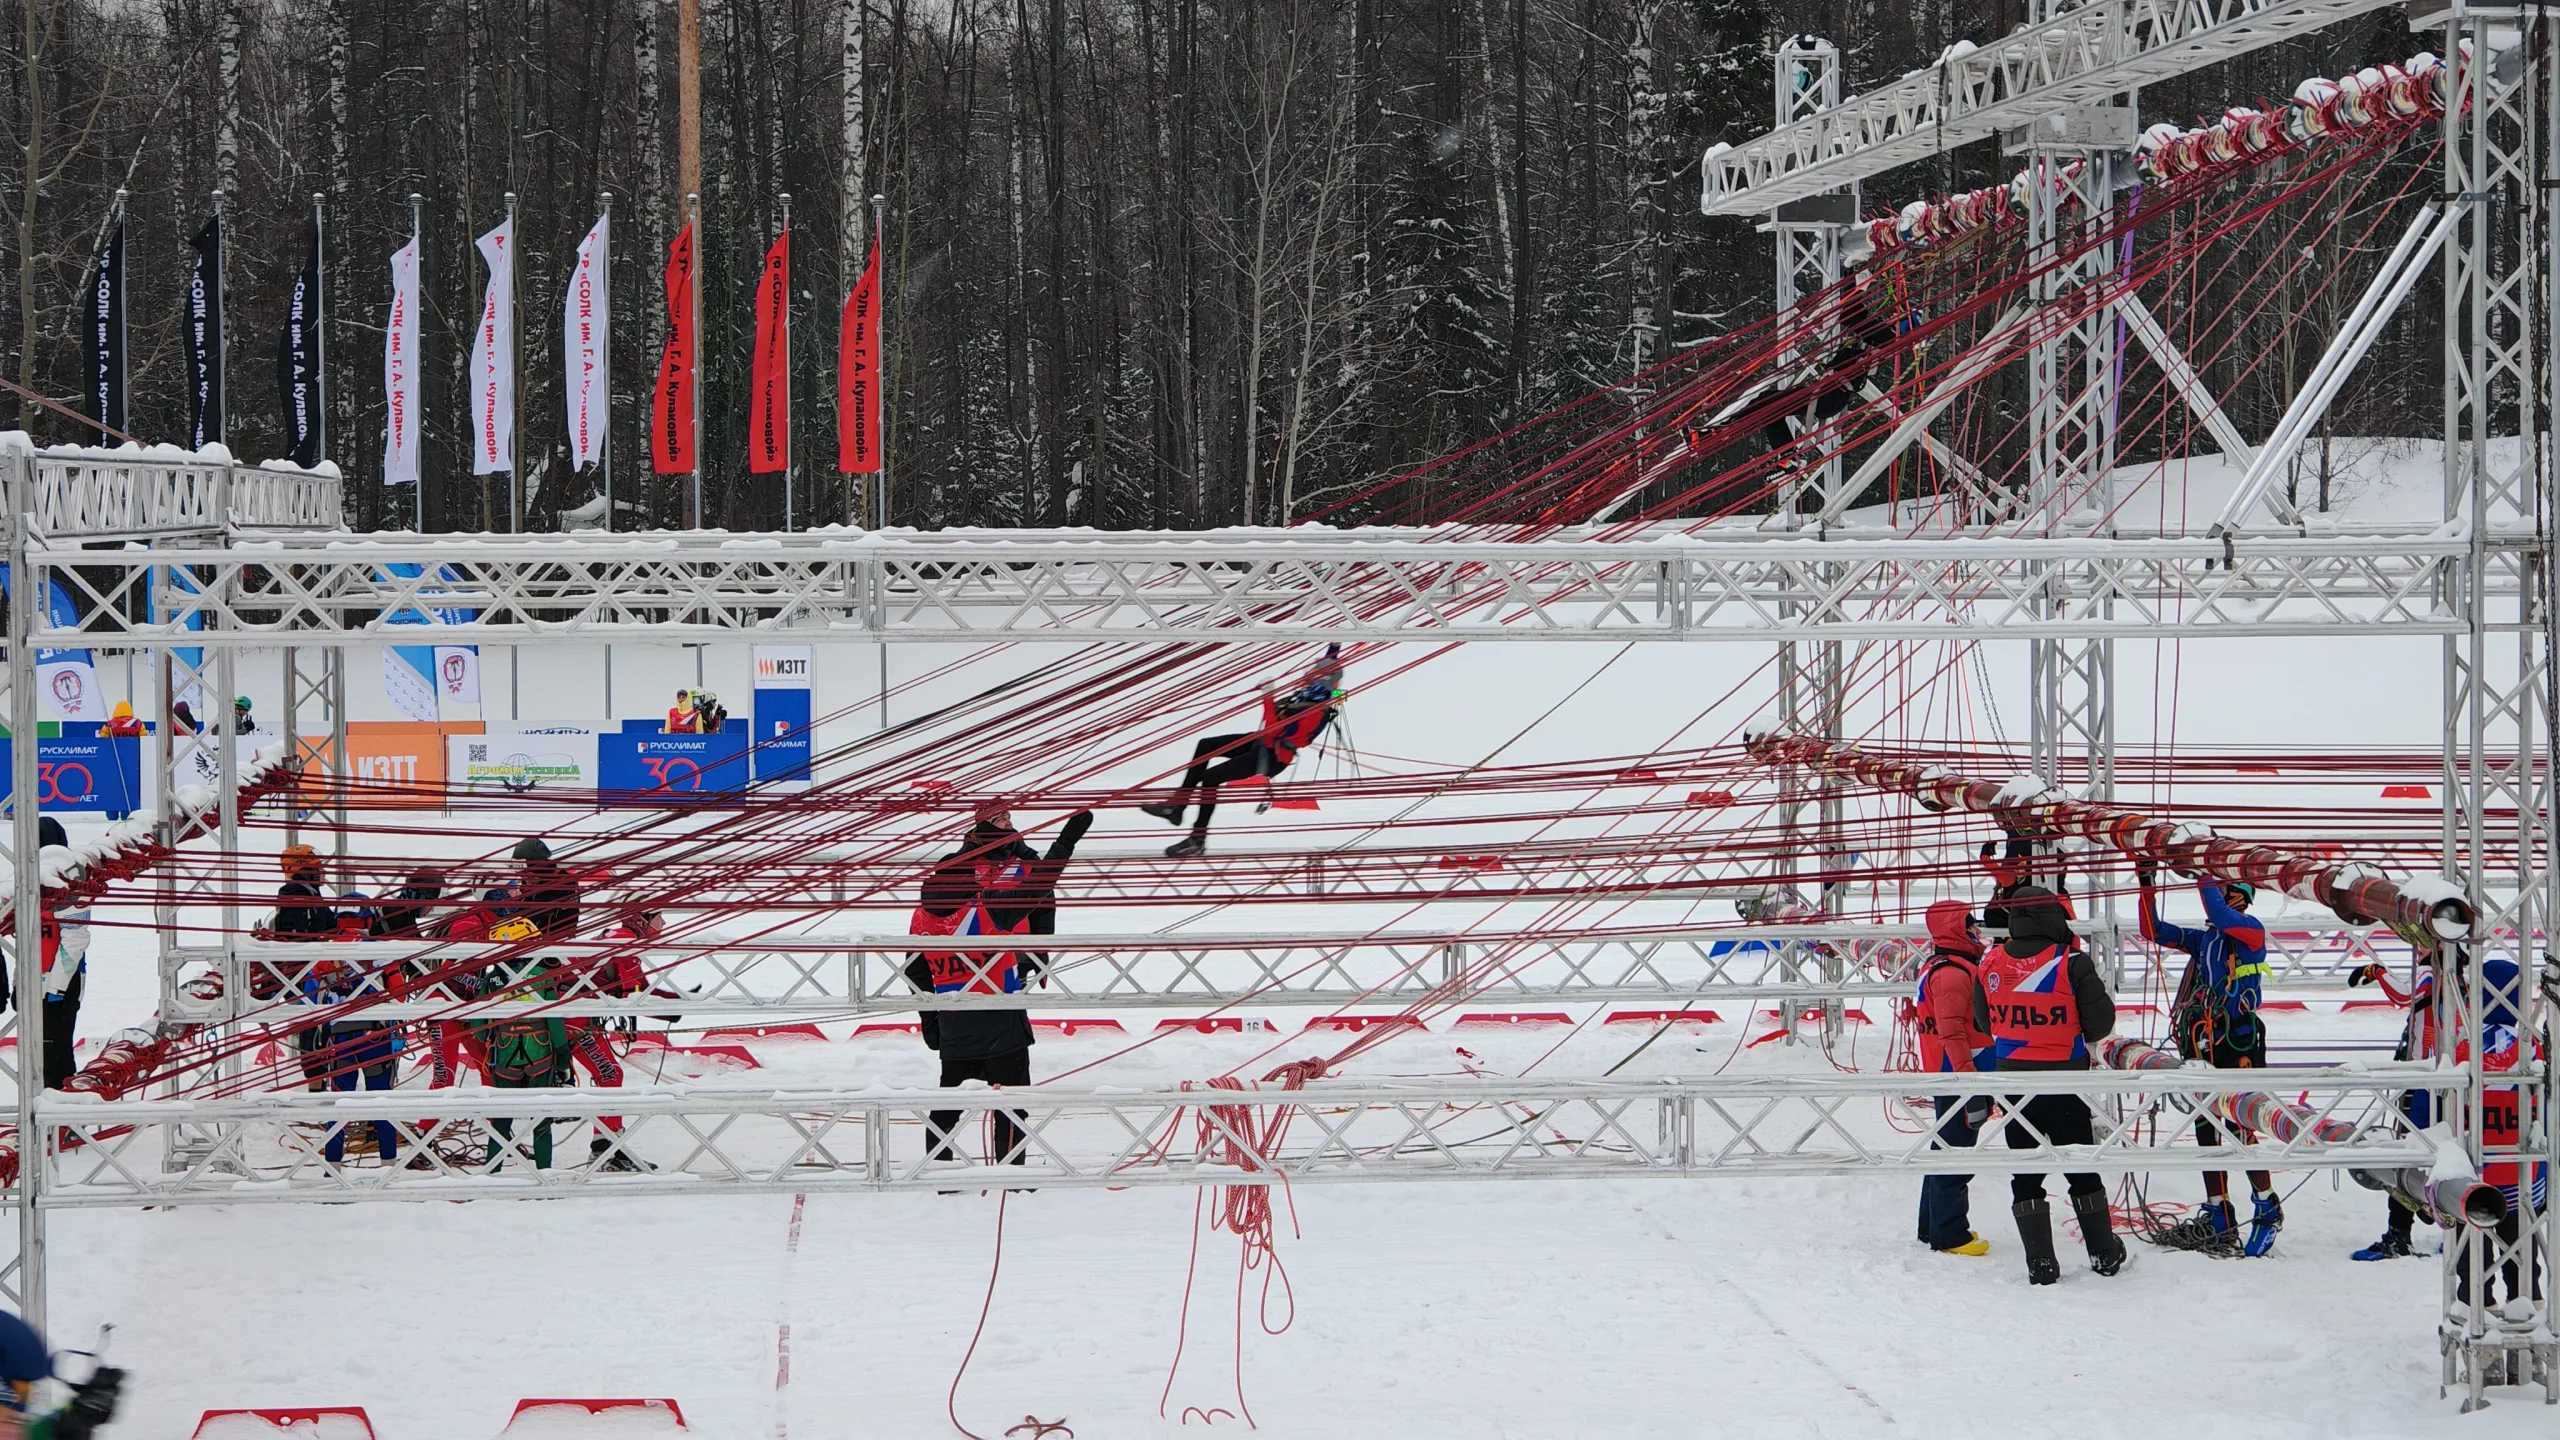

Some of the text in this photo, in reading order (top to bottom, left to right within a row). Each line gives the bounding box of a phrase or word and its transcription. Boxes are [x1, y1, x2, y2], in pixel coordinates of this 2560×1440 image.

[579, 273, 591, 318] «СОЛК
[98, 323, 108, 346] им.
[194, 322, 205, 346] им.
[291, 324, 302, 348] им.
[486, 324, 495, 347] им.
[580, 322, 591, 345] им.
[855, 323, 865, 345] им.
[392, 332, 403, 355] им.
[99, 351, 109, 359] Г.
[197, 350, 205, 359] Г.
[293, 351, 304, 360] Г.
[487, 351, 495, 360] Г.
[583, 349, 593, 357] Г.
[671, 350, 681, 359] Г.
[856, 349, 866, 358] Г.
[99, 364, 108, 378] А.
[198, 363, 207, 378] А.
[393, 359, 402, 369] Г.
[583, 362, 594, 376] А.
[670, 364, 680, 377] А.
[855, 362, 866, 376] А.
[293, 365, 305, 379] А.
[487, 365, 495, 378] А.
[393, 373, 403, 387] А.
[486, 382, 499, 463] Кулаковой»
[667, 382, 682, 462] Кулаковой»
[852, 380, 868, 462] Кулаковой»
[776, 660, 806, 674] ИЗТТ
[39, 746, 98, 754] РУСКЛИМАТ
[650, 742, 707, 750] РУСКЛИМАТ
[358, 756, 418, 787] ИЗТТ
[36, 763, 93, 803] 30
[79, 794, 99, 802] ЛЕТ
[1989, 1004, 2068, 1029] СУДЬЯ
